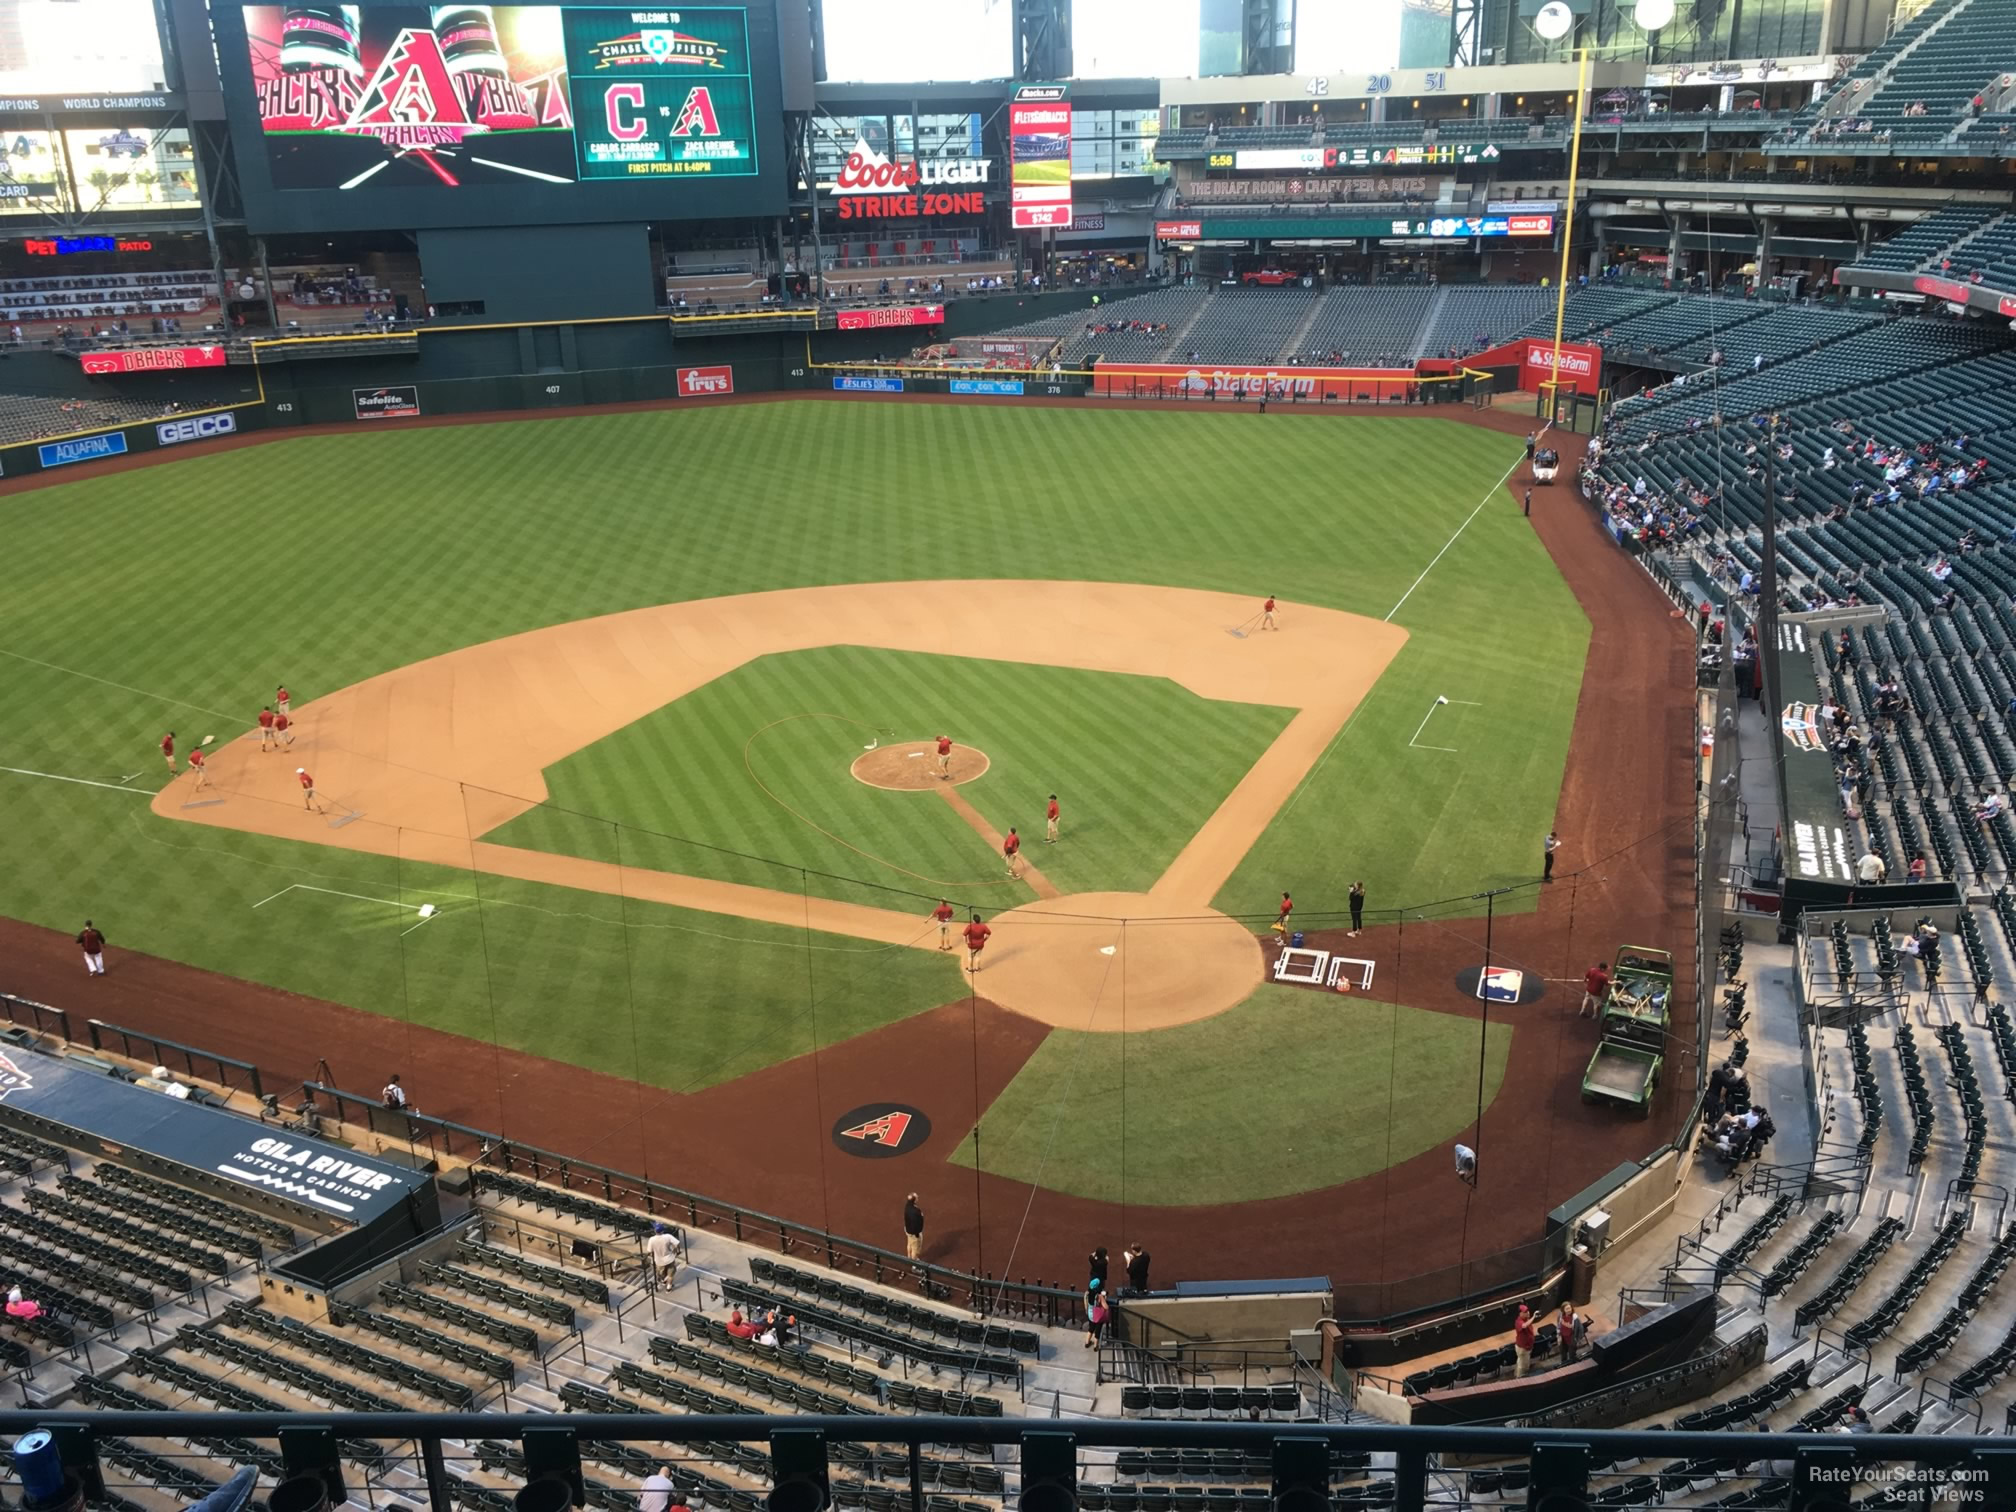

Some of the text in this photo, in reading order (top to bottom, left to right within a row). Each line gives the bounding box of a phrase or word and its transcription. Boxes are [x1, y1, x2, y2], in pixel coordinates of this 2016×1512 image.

[631, 13, 680, 23] WELCOME TO
[603, 44, 714, 56] CHASE FIELD
[1306, 77, 1328, 95] 42
[1366, 75, 1391, 93] 20
[1424, 72, 1446, 91] 51
[63, 97, 166, 109] WORLD CHAMPIONS
[659, 106, 670, 117] VS
[1210, 155, 1233, 166] 5:58
[1464, 155, 1478, 163] OUT
[628, 163, 650, 173] FIRST
[651, 162, 673, 172] PITCH
[674, 162, 683, 171] AT
[837, 152, 992, 188] Coors LIGHT
[1190, 182, 1211, 195] THE
[1214, 181, 1250, 195] DRAFT
[1252, 180, 1286, 194] ROOM
[1305, 179, 1341, 194] CRAFT
[1377, 178, 1389, 192] &
[1391, 177, 1426, 192] BITES
[838, 191, 985, 219] STRIKE ZONE
[1032, 213, 1053, 224] $742
[1074, 219, 1104, 230] FITNESS
[1391, 221, 1409, 229] GAME
[1512, 221, 1537, 229] CIRCLE
[118, 241, 152, 251] PATIO
[983, 343, 995, 353] RAM
[791, 369, 804, 377] 413
[683, 370, 728, 391] fry's
[546, 385, 560, 394] 407
[1048, 386, 1061, 394] 376
[358, 395, 403, 406] Safelite
[384, 402, 416, 410] AutoGlass
[276, 403, 293, 412] 413
[159, 414, 233, 443] GEICO
[56, 437, 113, 462] AQUAFINA
[251, 1138, 312, 1167] GILA
[233, 1152, 372, 1201] HOTELS & CASINOS
